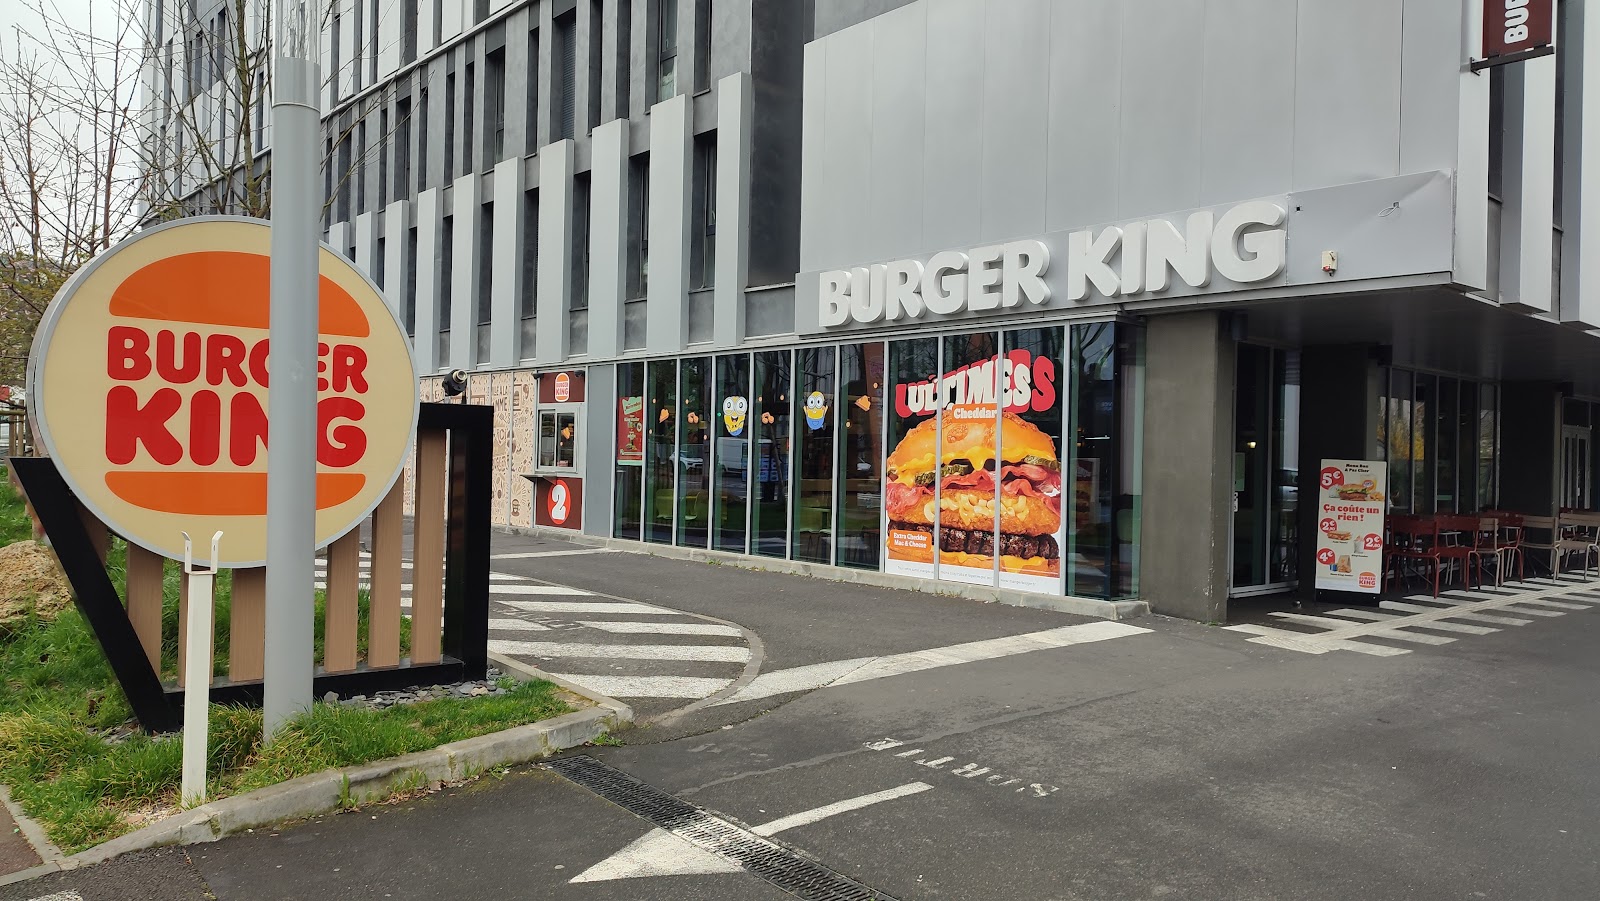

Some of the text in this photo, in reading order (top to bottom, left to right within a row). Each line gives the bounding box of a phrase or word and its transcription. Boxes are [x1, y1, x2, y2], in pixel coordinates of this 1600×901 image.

[819, 201, 1286, 327] BURGER KING
[556, 388, 569, 396] KING
[953, 408, 997, 419] Cheddar
[551, 484, 567, 521] 2
[1323, 503, 1336, 513] Ça
[1337, 504, 1365, 513] coûte
[1337, 512, 1359, 522] rien
[907, 533, 927, 541] Cheddar
[909, 540, 927, 549] Cheese
